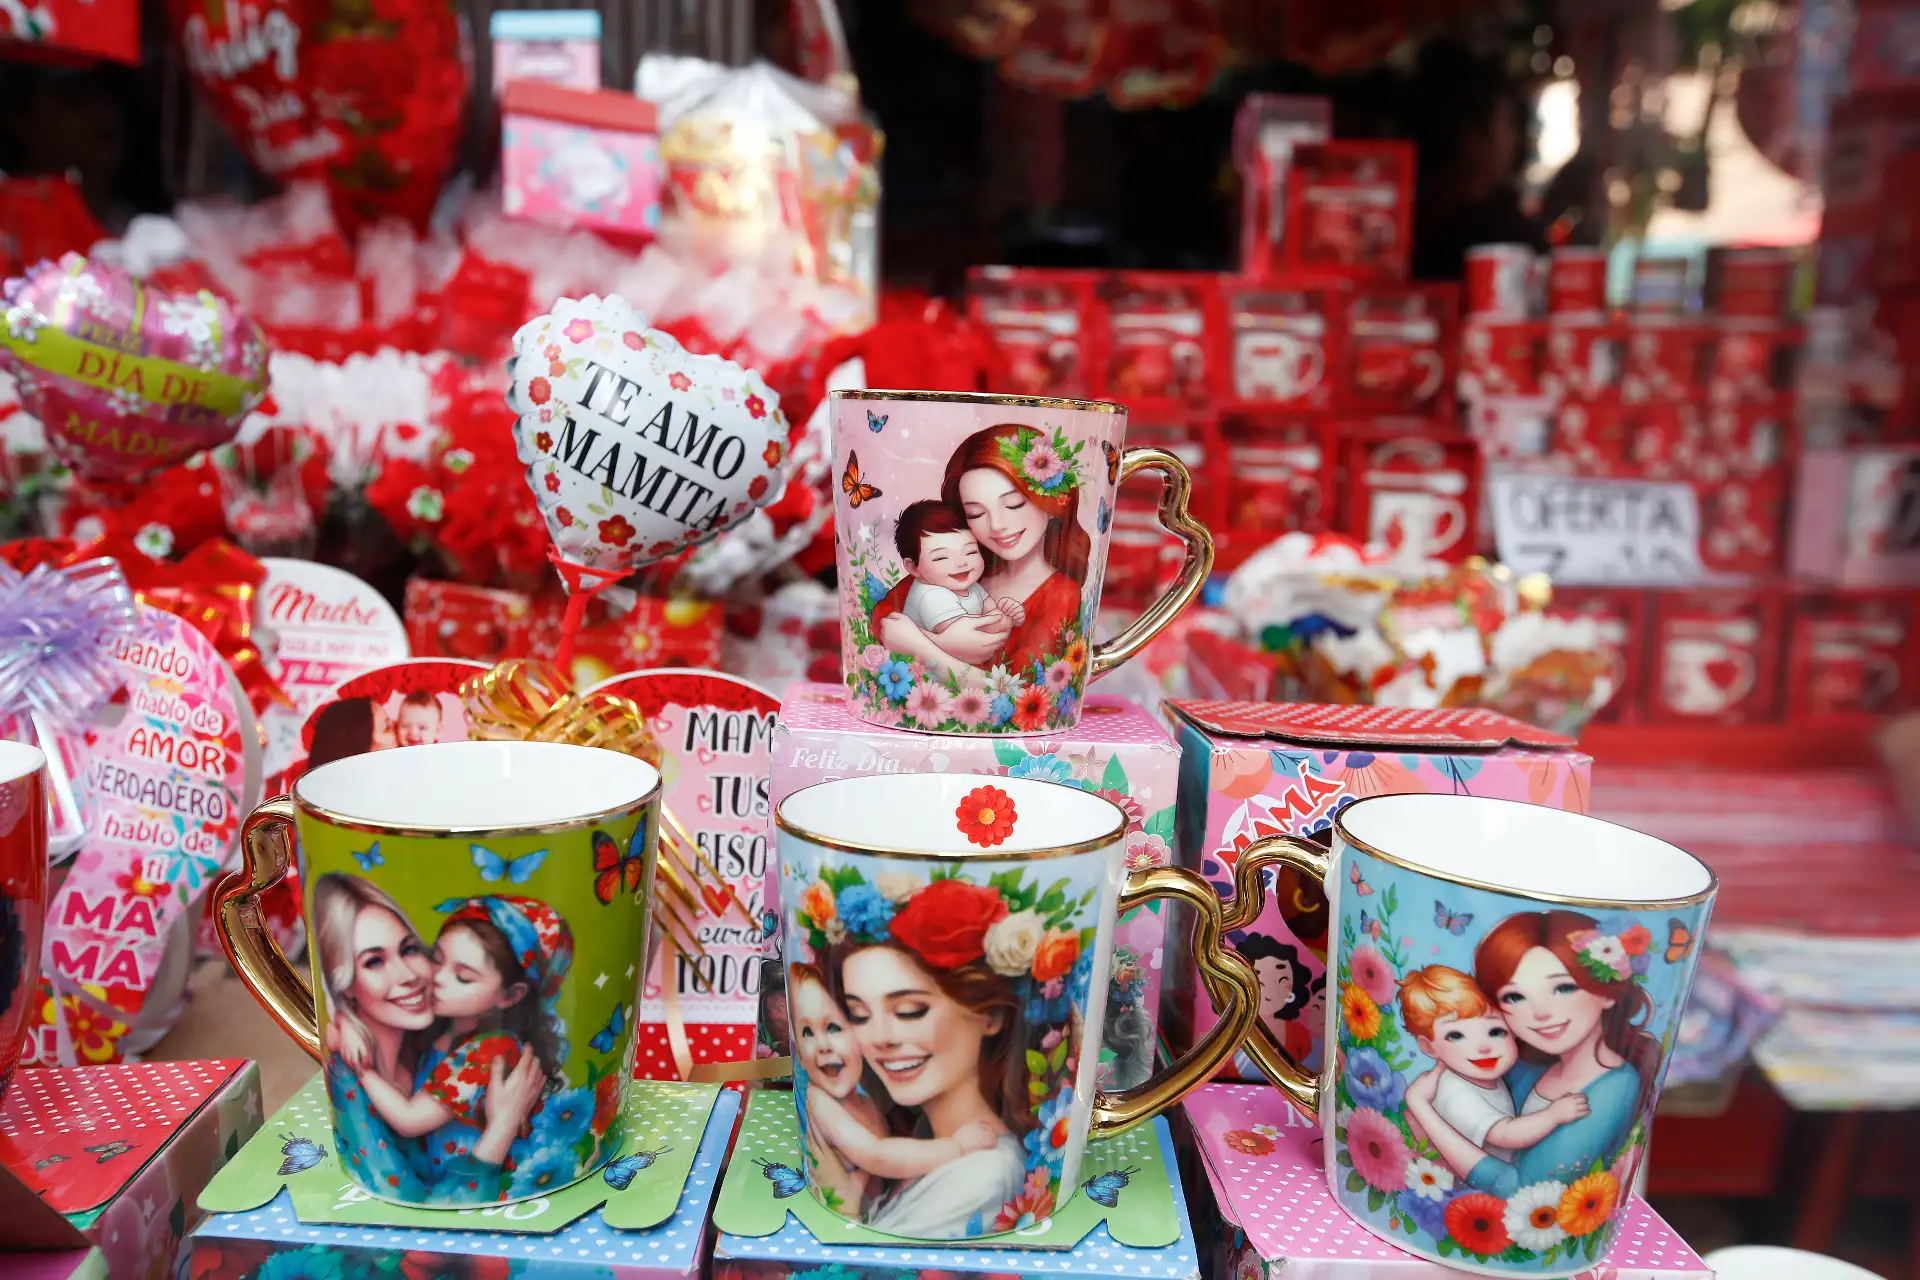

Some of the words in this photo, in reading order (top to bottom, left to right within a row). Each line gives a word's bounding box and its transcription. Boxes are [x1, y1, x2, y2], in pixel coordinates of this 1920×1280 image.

[76, 350, 146, 395] DÍA
[159, 373, 211, 405] DE
[576, 361, 642, 427] TE
[636, 401, 746, 480] AMO
[552, 416, 728, 532] MAMITA
[109, 638, 189, 678] uando
[136, 688, 188, 722] hablo
[193, 707, 221, 730] de
[129, 727, 221, 776] AMOR
[685, 711, 774, 754] MAM
[789, 747, 849, 772] Feliz
[710, 775, 771, 818] TUS
[104, 814, 175, 847] hablo
[184, 831, 214, 854] de
[694, 831, 769, 878] BESO
[62, 890, 157, 937] MA
[697, 926, 763, 945] cura
[51, 938, 142, 986] MÁ
[674, 953, 762, 996] TODO
